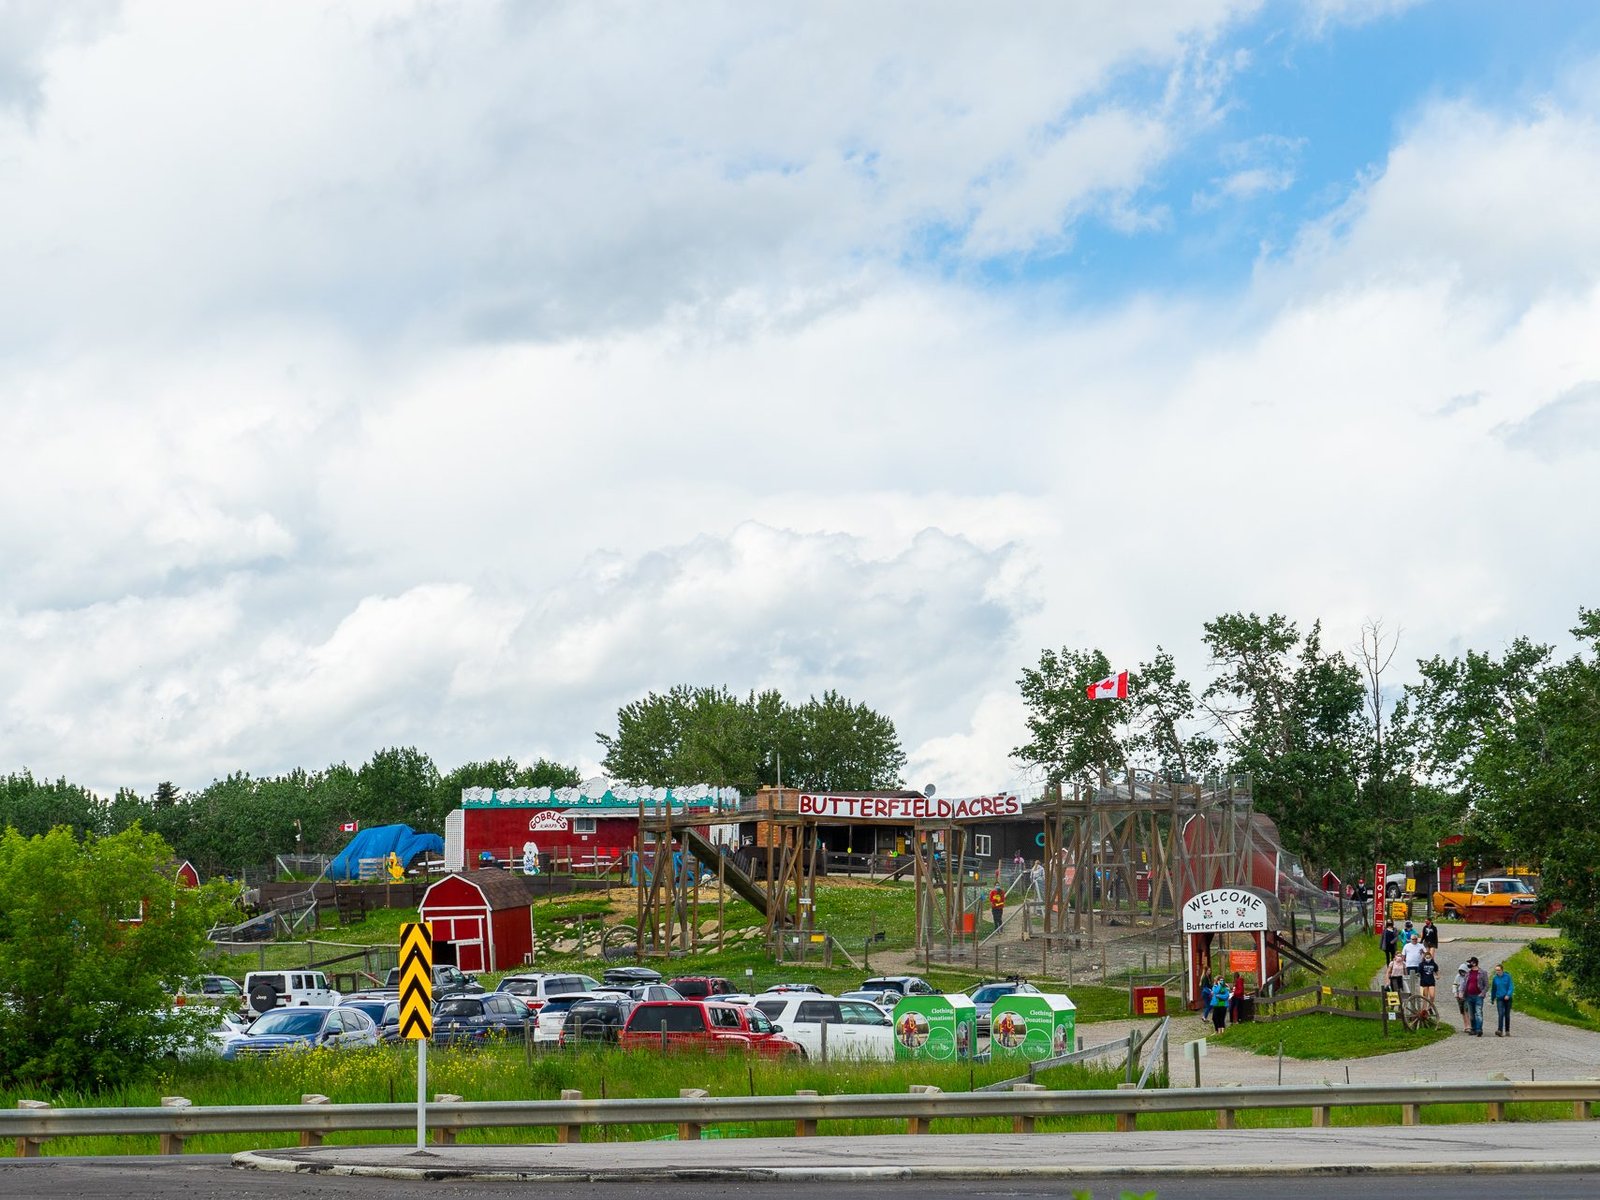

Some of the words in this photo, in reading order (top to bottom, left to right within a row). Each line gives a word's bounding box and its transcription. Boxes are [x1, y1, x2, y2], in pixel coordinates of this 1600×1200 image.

[800, 795, 952, 817] BUTTERFIELD
[955, 796, 1018, 816] ACRES
[530, 811, 567, 829] GOBBLES
[1188, 891, 1262, 911] WELCOME
[1186, 921, 1235, 930] Butterfield
